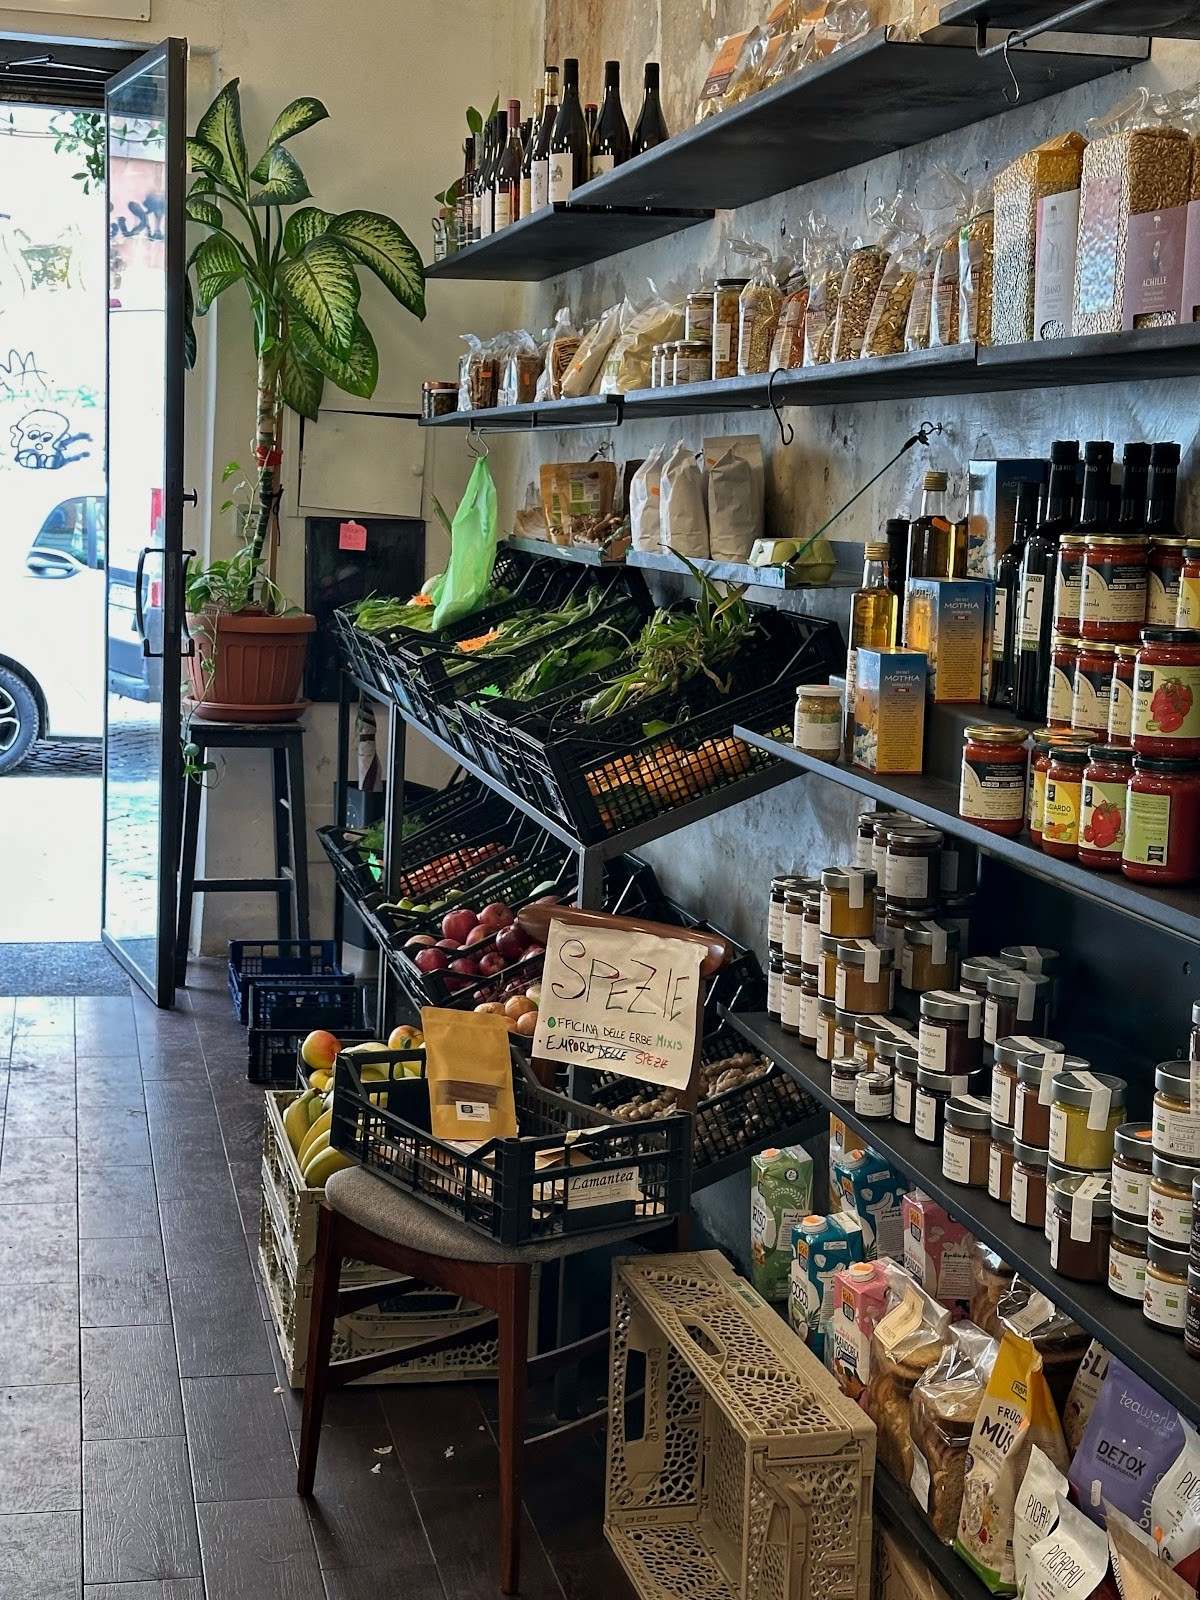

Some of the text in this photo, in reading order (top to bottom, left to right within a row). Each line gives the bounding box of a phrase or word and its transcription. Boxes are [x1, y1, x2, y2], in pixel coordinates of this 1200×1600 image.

[1141, 275, 1167, 288] ACHILLE
[944, 601, 980, 610] MOTHIA
[884, 675, 921, 683] MOTHIA
[551, 939, 690, 1022] SPEZIE
[547, 1016, 598, 1036] OFFICINA
[603, 1027, 626, 1040] DELLE
[628, 1032, 653, 1046] ERBE
[546, 1035, 668, 1069] EMPORIO DELLE SPEZIE
[570, 1171, 634, 1191] Lamantea
[1119, 1390, 1178, 1433] teaworld
[1097, 1440, 1147, 1477] DETOX
[1042, 1544, 1086, 1590] PICAPAU
